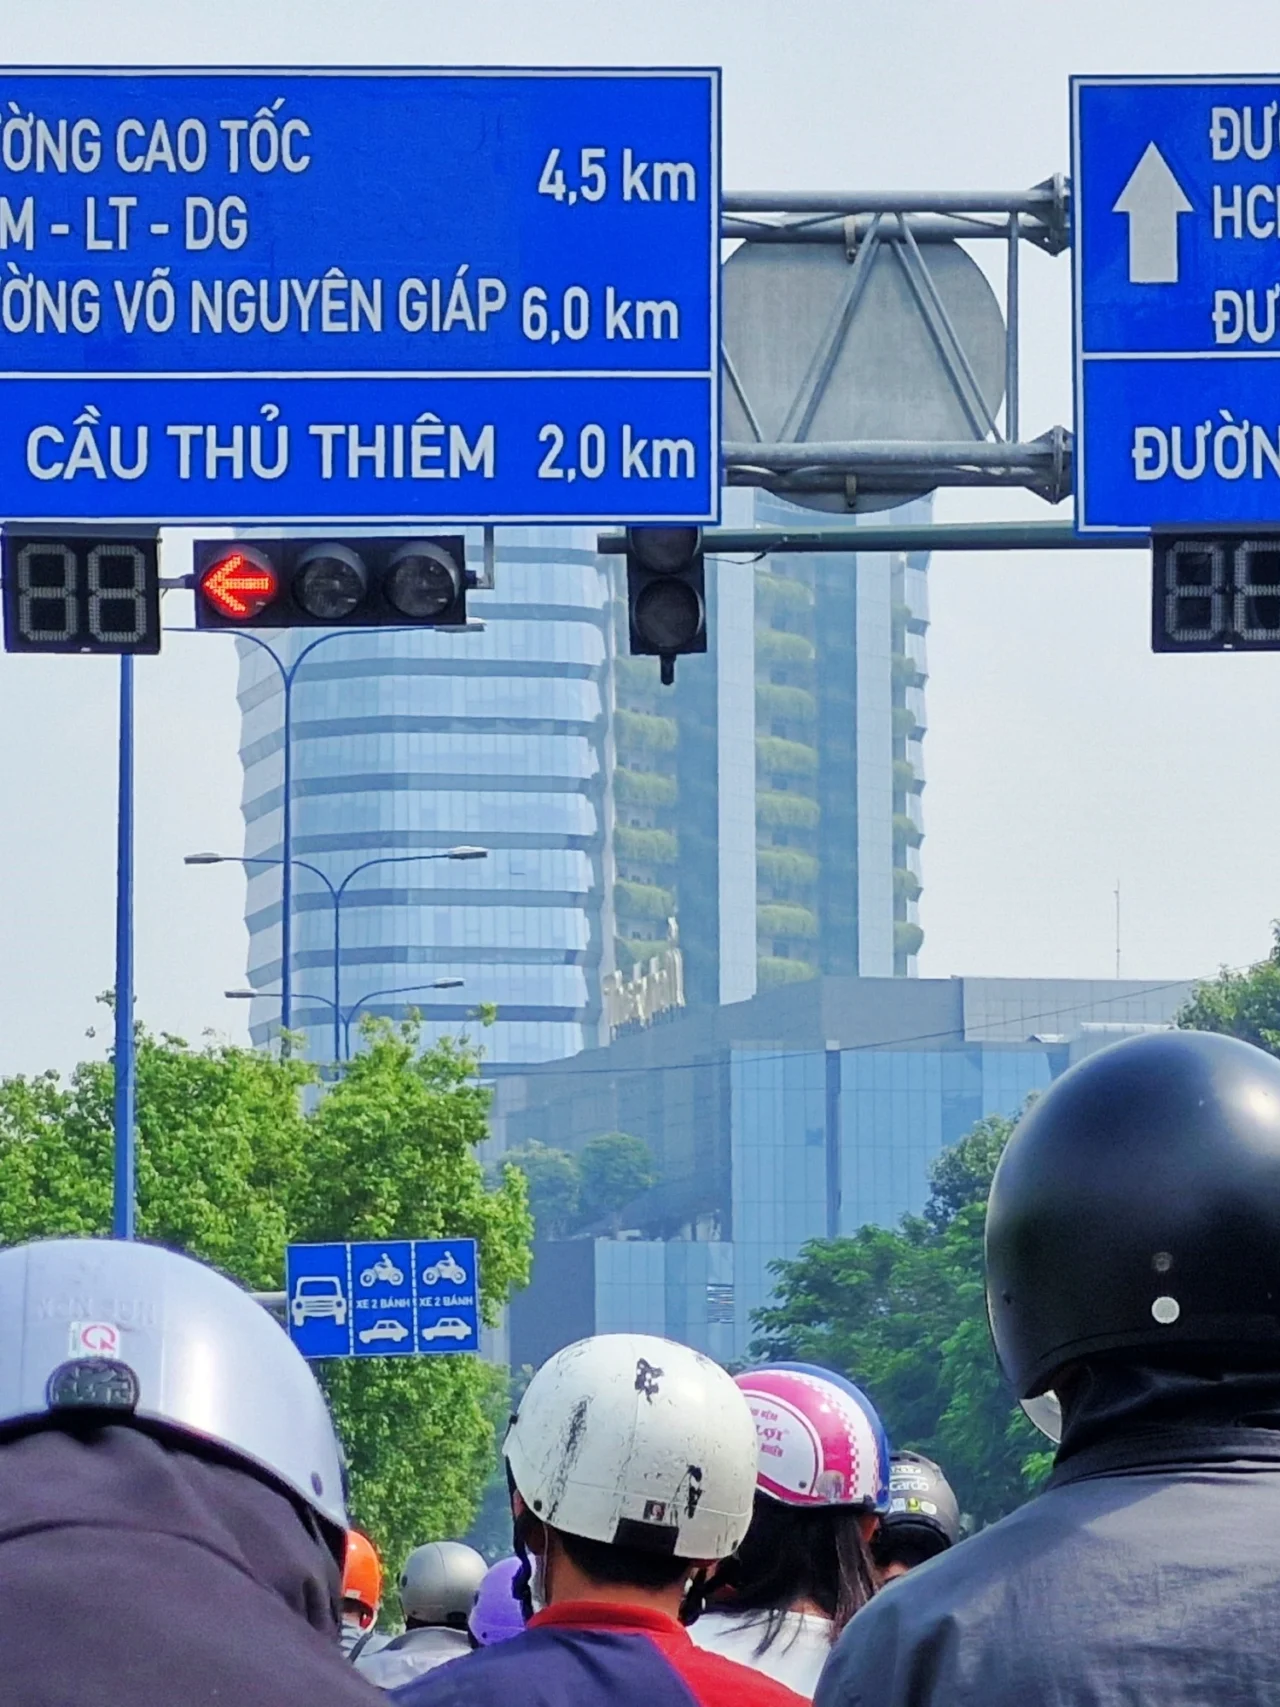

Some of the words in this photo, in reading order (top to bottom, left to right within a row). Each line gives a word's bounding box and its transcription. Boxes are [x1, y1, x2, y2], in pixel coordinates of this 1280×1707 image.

[0, 101, 100, 173] ỜNG
[116, 118, 207, 173] CAO
[220, 98, 310, 173] TỐC
[538, 148, 606, 205] 4,5
[623, 148, 696, 201] km
[86, 196, 137, 250] LT
[186, 195, 248, 250] DG
[0, 262, 100, 333] ỜNG
[114, 267, 175, 333] VÕ
[191, 267, 382, 334] NGUYÊN
[399, 264, 507, 332] GIÁP
[522, 286, 589, 344] 6,0
[606, 286, 678, 339] km
[27, 405, 148, 480] CẦU
[166, 403, 288, 480] THỦ
[309, 412, 494, 480] THIÊM
[538, 424, 605, 482] 2,0
[622, 424, 695, 478] km
[356, 1299, 369, 1309] XE
[372, 1299, 378, 1309] 2
[380, 1296, 411, 1309] BÁNH
[420, 1297, 433, 1307] XE
[434, 1297, 441, 1307] 2
[443, 1294, 473, 1307] BÁNH
